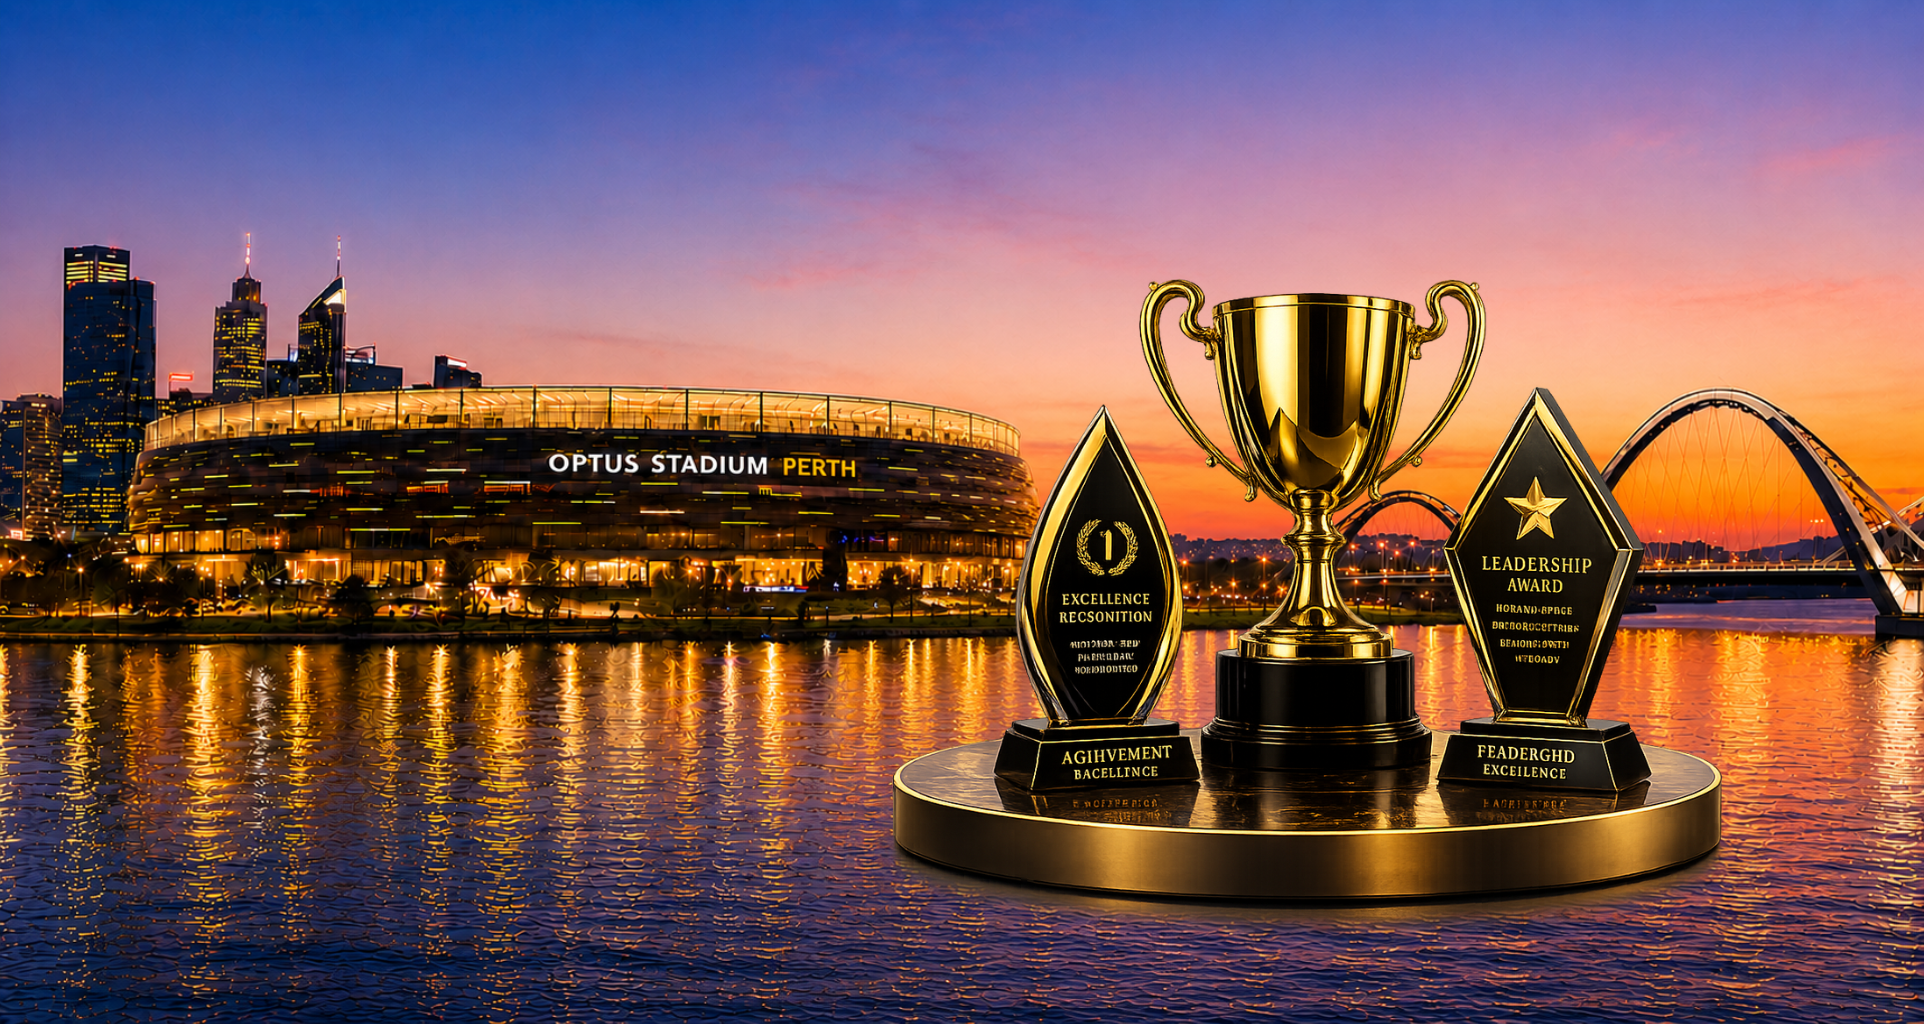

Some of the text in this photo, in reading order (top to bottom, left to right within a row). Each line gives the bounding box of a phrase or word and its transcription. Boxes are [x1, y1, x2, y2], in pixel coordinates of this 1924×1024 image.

[549, 453, 856, 478] OPTUS STADIUM PERTH
[1099, 529, 1112, 560] 1
[1481, 555, 1592, 574] LEADERSHIP
[1507, 577, 1563, 593] AWARD
[1061, 593, 1150, 606] EXCELLENCE
[1059, 610, 1152, 624] RECSONITION
[1477, 744, 1575, 764] FEADERGHD
